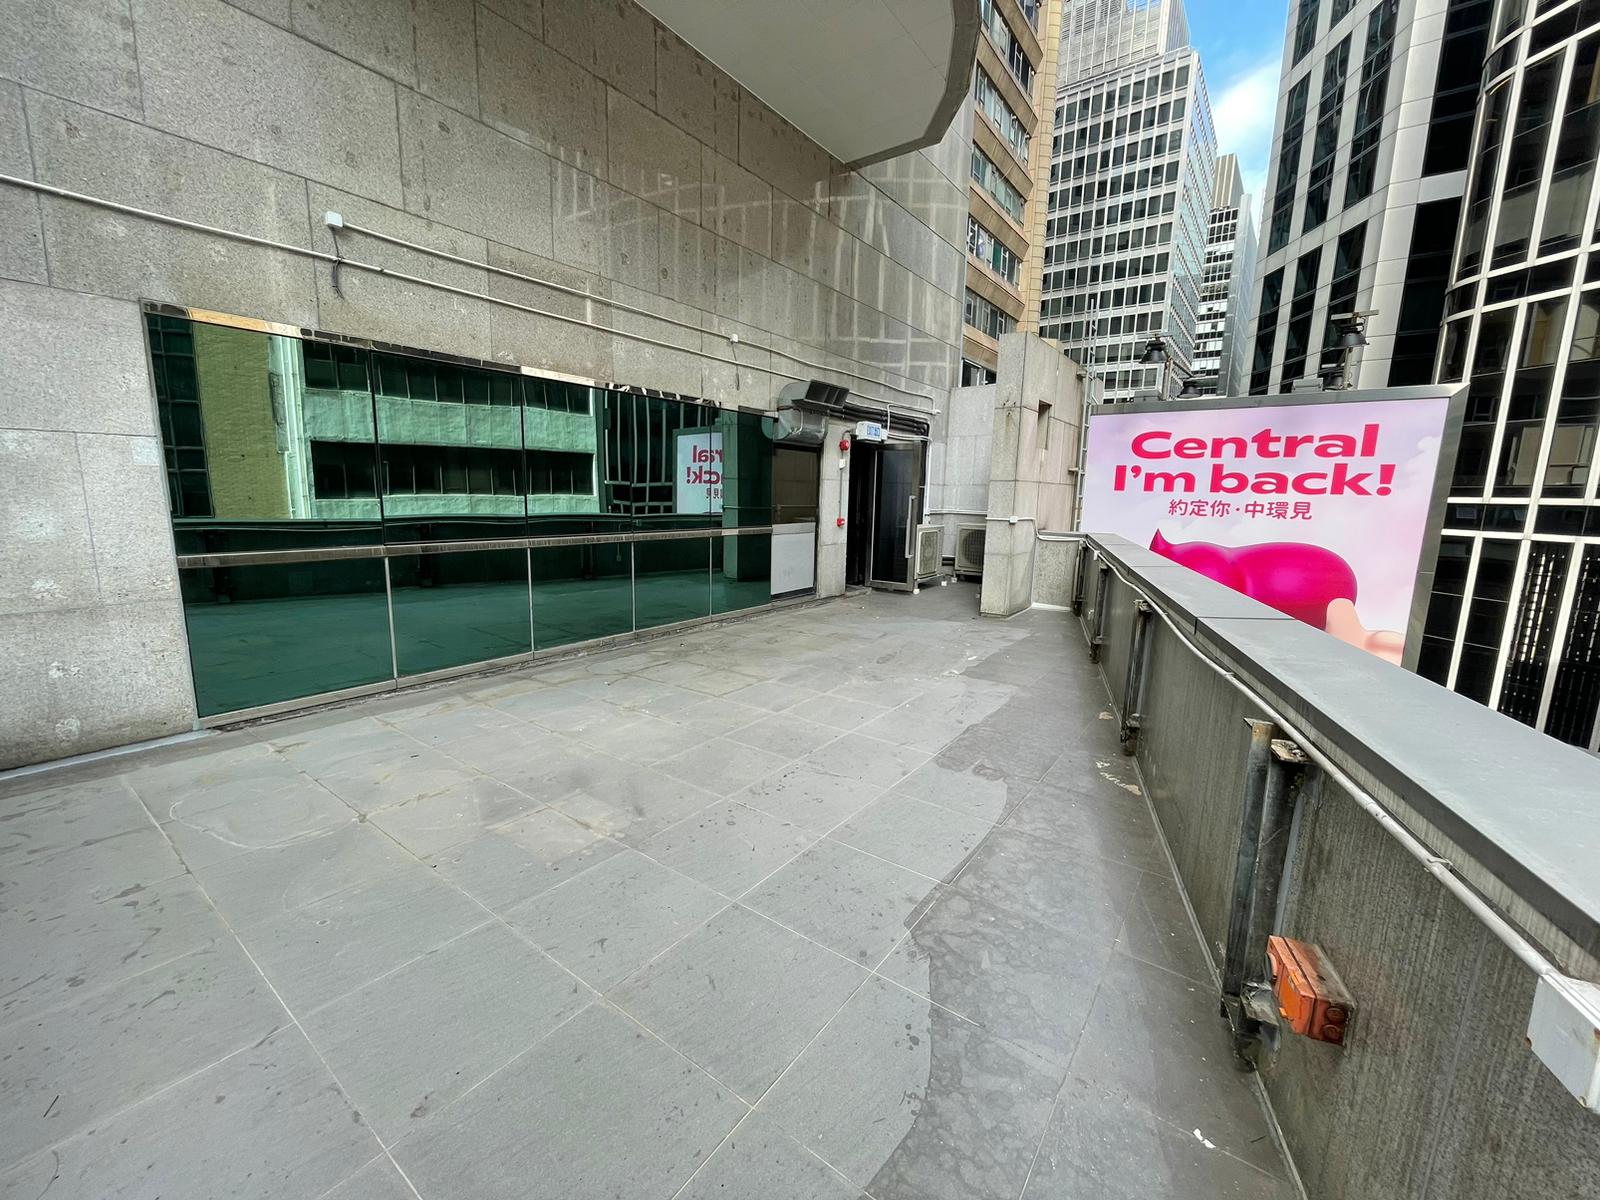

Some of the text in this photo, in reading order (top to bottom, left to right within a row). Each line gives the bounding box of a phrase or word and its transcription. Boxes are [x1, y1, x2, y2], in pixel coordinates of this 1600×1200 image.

[1131, 424, 1380, 459] Central
[1114, 463, 1397, 496] I’m back!
